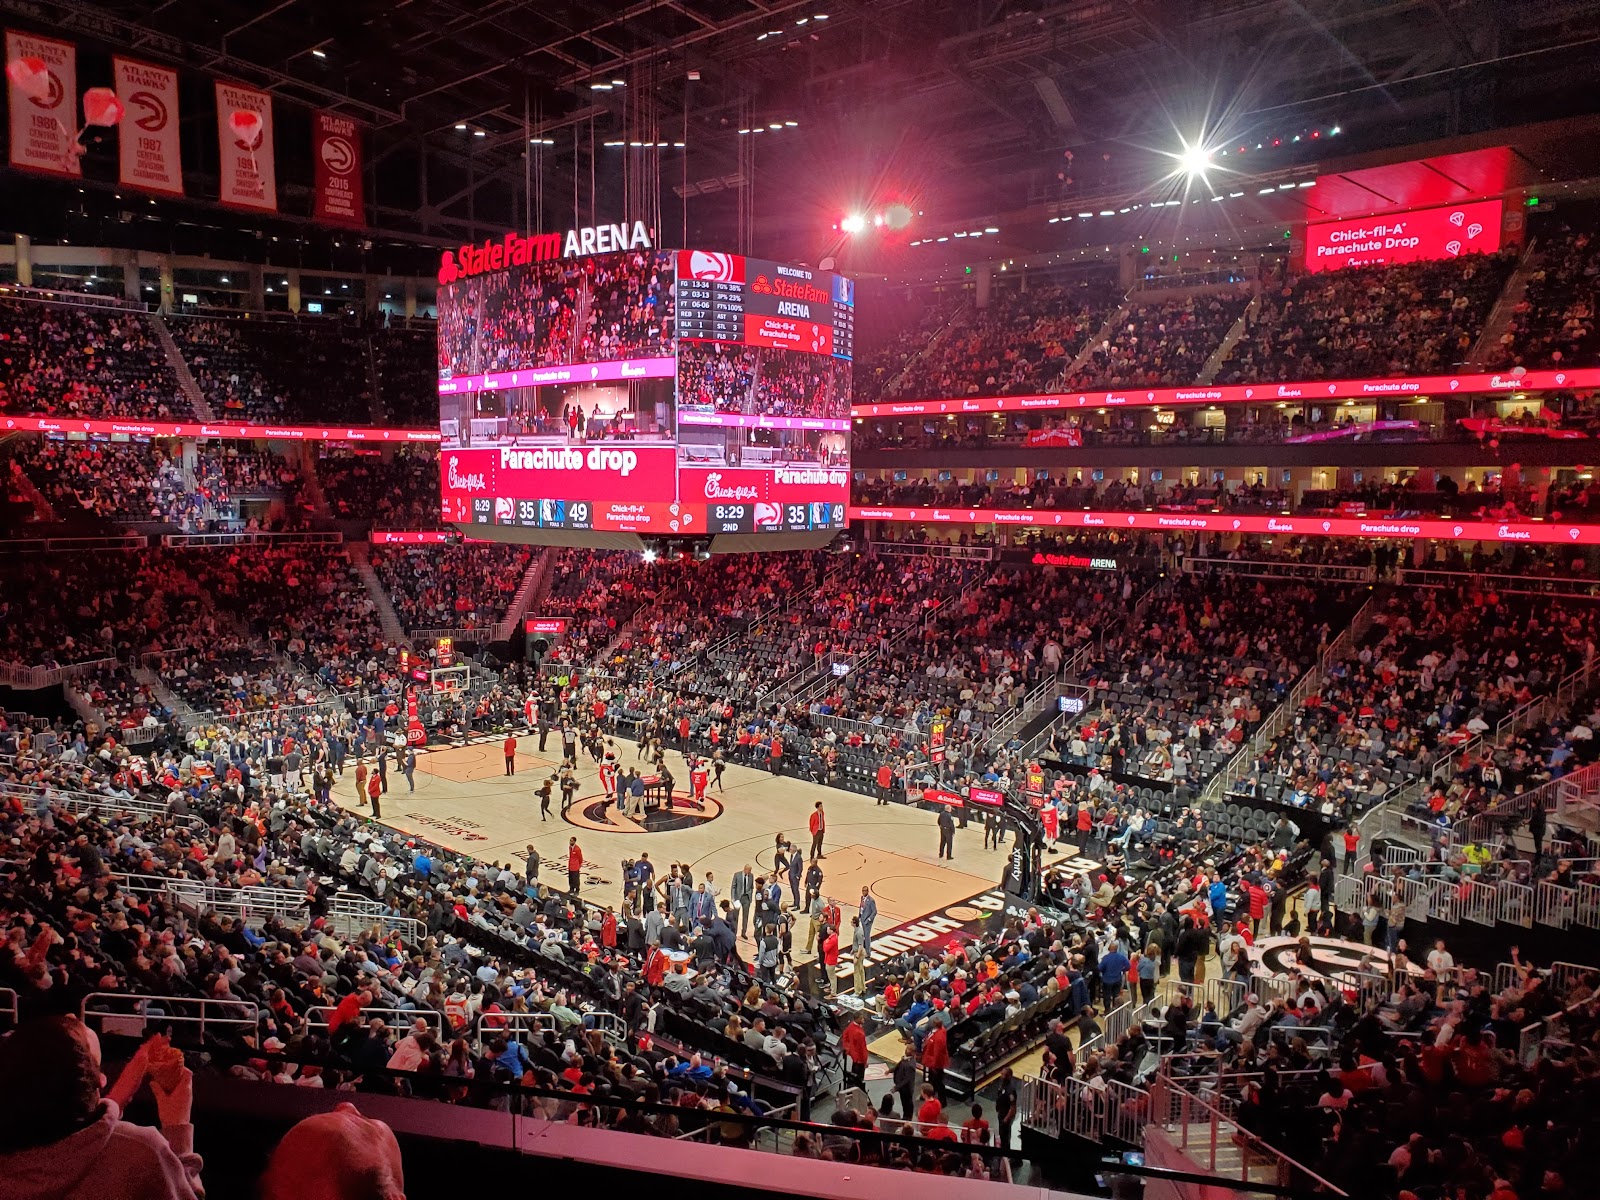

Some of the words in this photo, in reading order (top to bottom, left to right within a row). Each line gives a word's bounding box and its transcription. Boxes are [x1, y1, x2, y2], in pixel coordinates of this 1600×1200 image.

[16, 39, 68, 57] ATLANTA
[122, 64, 170, 83] ATLANTA
[126, 74, 166, 91] HAWKS
[222, 89, 266, 106] ATLANTA
[320, 116, 355, 130] ATLANTA
[323, 123, 352, 137] HAWKS
[138, 137, 162, 152] 1987
[136, 150, 164, 163] CENTRAL
[138, 160, 165, 172] DIVISION
[133, 169, 170, 183] CHAMPIONS
[328, 176, 348, 190] 2015
[564, 220, 653, 258] ARENA
[1317, 240, 1382, 257] Parachute
[1385, 236, 1420, 248] Drop
[777, 266, 804, 279] WELCOME
[804, 272, 812, 280] TO
[728, 304, 743, 312] 100%
[777, 300, 810, 318] ARENA
[760, 328, 788, 339] Parachute
[787, 332, 800, 342] drop
[1363, 383, 1400, 392] Parachute
[1401, 382, 1420, 392] drop
[1176, 391, 1206, 399] Parachute
[1206, 390, 1222, 399] drop
[1046, 398, 1059, 406] drop
[112, 424, 140, 432] Parachute
[141, 426, 154, 434] drop
[290, 430, 303, 438] drop
[500, 447, 584, 470] Parachute
[586, 445, 638, 476] drop
[774, 469, 828, 485] Parachute
[828, 471, 848, 488] drop
[475, 500, 490, 512] 8:29
[519, 502, 534, 520] 35
[569, 503, 588, 522] 49
[716, 506, 744, 519] 8:29
[832, 504, 844, 522] 49
[606, 512, 635, 522] Parachute
[636, 515, 650, 523] drop
[788, 506, 805, 524] 35
[994, 513, 1020, 521] Parachute
[1021, 514, 1034, 522] drop
[722, 523, 738, 532] 2ND
[1158, 518, 1190, 526] Parachute
[1191, 518, 1207, 528] drop
[1360, 524, 1400, 532] Parachute
[1400, 524, 1420, 534] drop
[1090, 558, 1116, 568] ARENA
[439, 645, 450, 654] 24
[408, 731, 420, 739] KIA
[1012, 848, 1024, 882] xfinity
